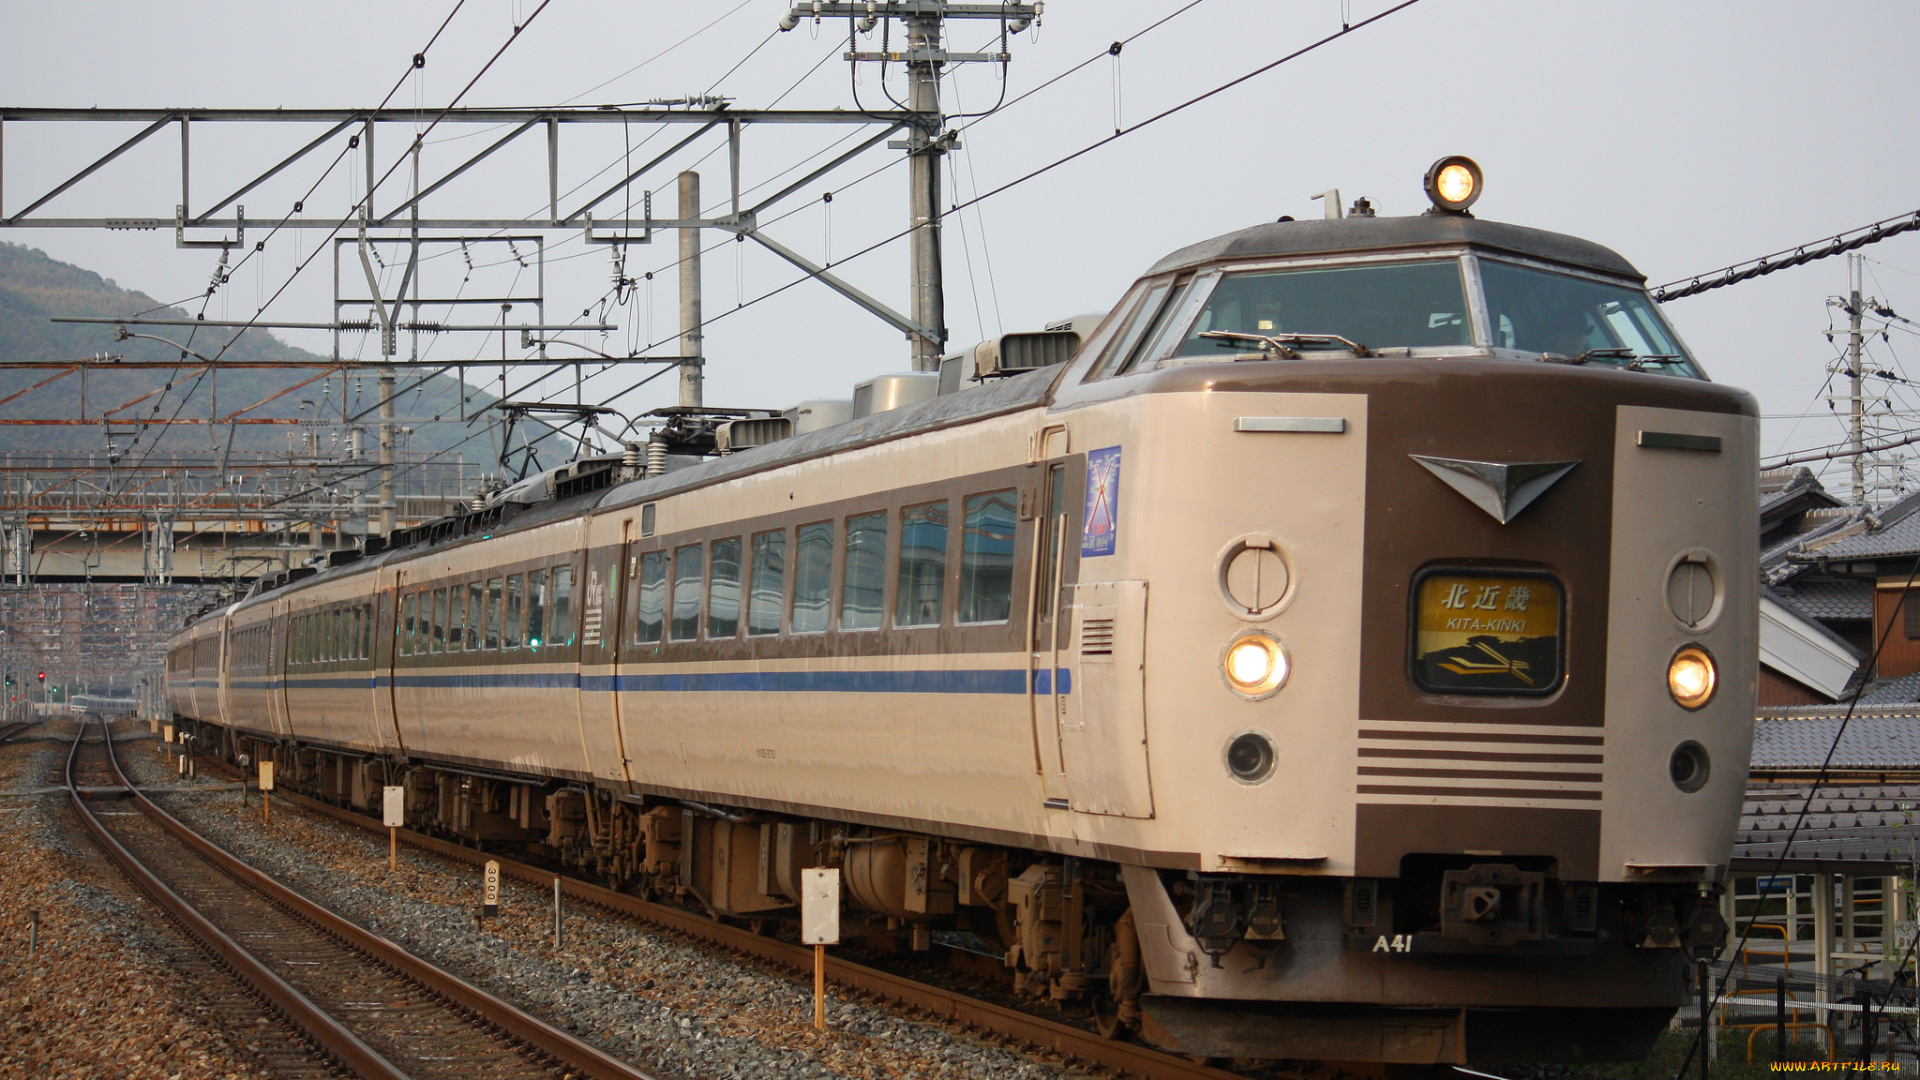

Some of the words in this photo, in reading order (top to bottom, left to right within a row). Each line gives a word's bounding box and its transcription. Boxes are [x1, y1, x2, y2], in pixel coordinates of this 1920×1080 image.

[1442, 584, 1530, 611] 北近畿
[1446, 618, 1527, 632] KITA-KINKI
[487, 867, 497, 900] 3000
[1372, 934, 1413, 953] A41
